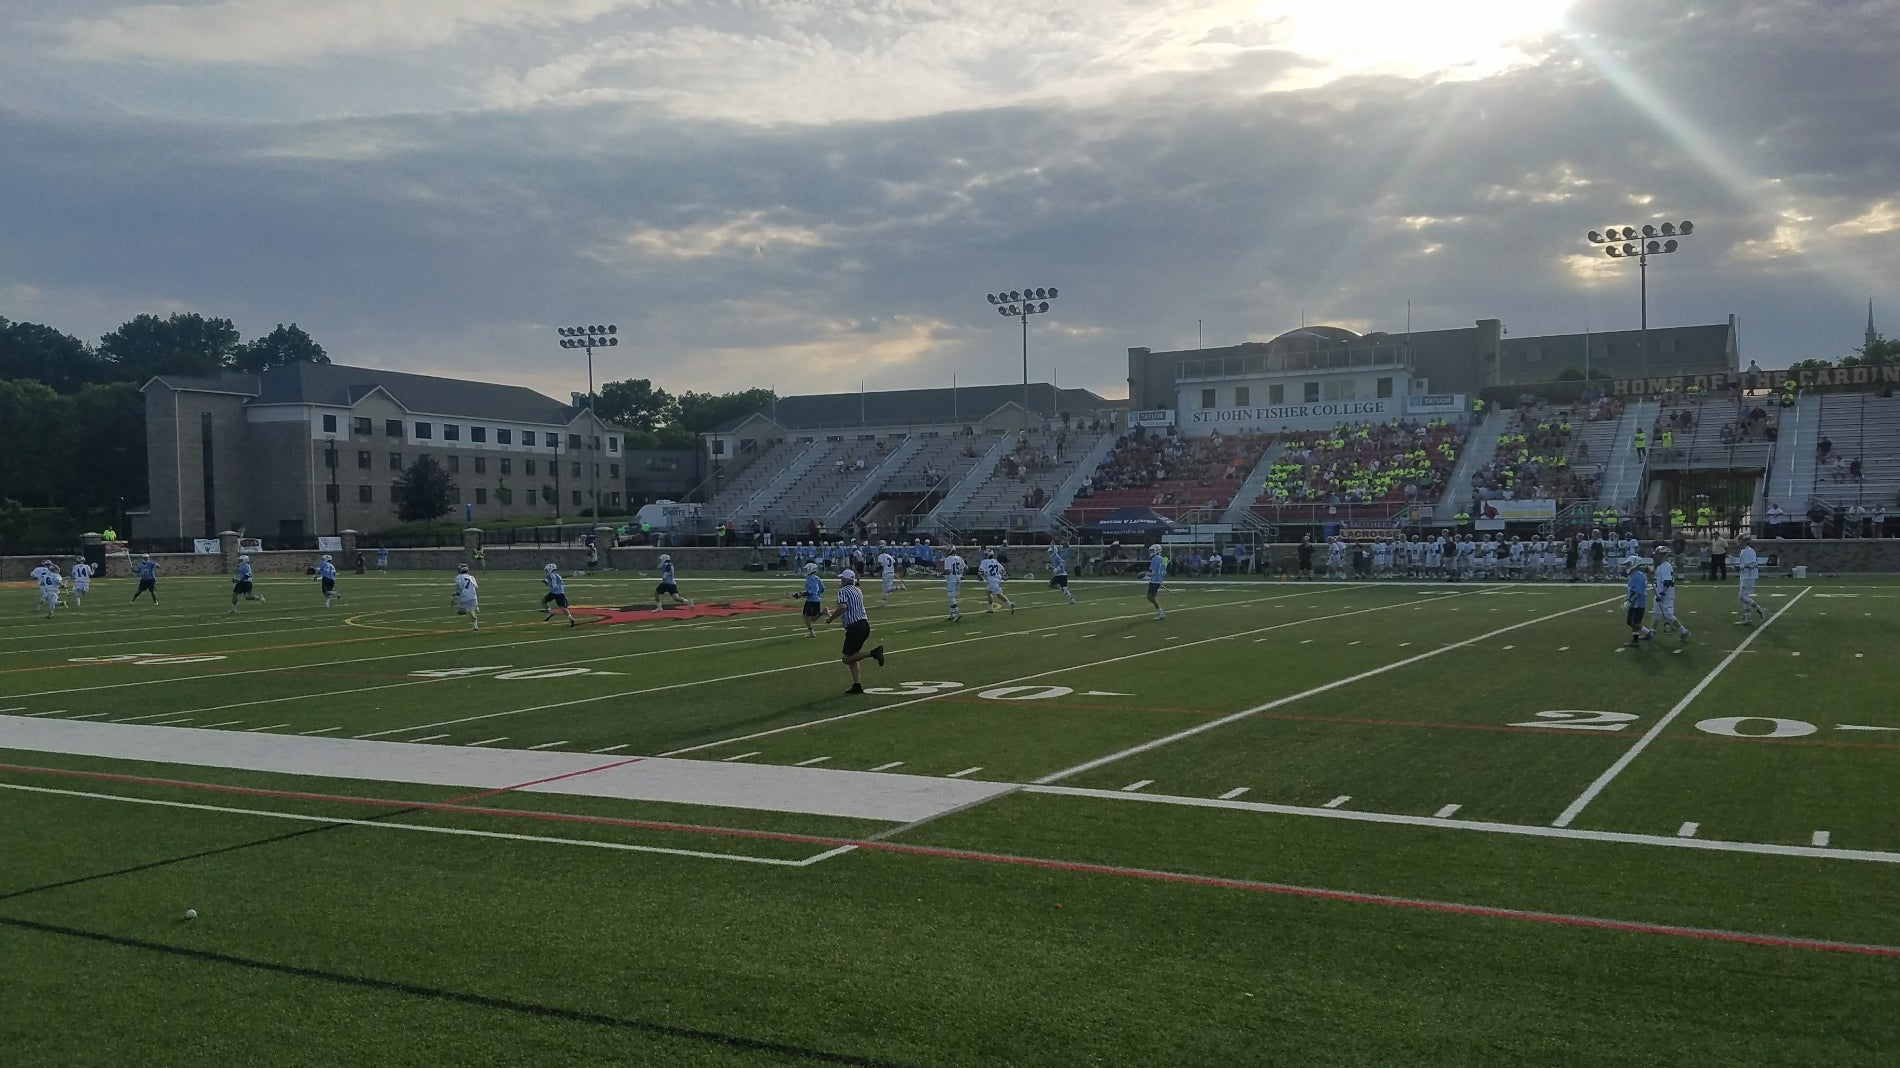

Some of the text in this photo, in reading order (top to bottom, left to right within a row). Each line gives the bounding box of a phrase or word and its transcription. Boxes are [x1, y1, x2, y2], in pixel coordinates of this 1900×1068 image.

[1614, 376, 1684, 395] HOME
[1424, 397, 1453, 405] TAYLOR
[1140, 412, 1165, 421] TAYLOR
[1193, 401, 1384, 423] ST. JOHN FISHER COLLEGE
[1341, 530, 1399, 538] LACROSSE
[886, 558, 892, 568] 3
[78, 568, 87, 577] 14
[988, 565, 999, 577] 27
[464, 577, 471, 589] 7
